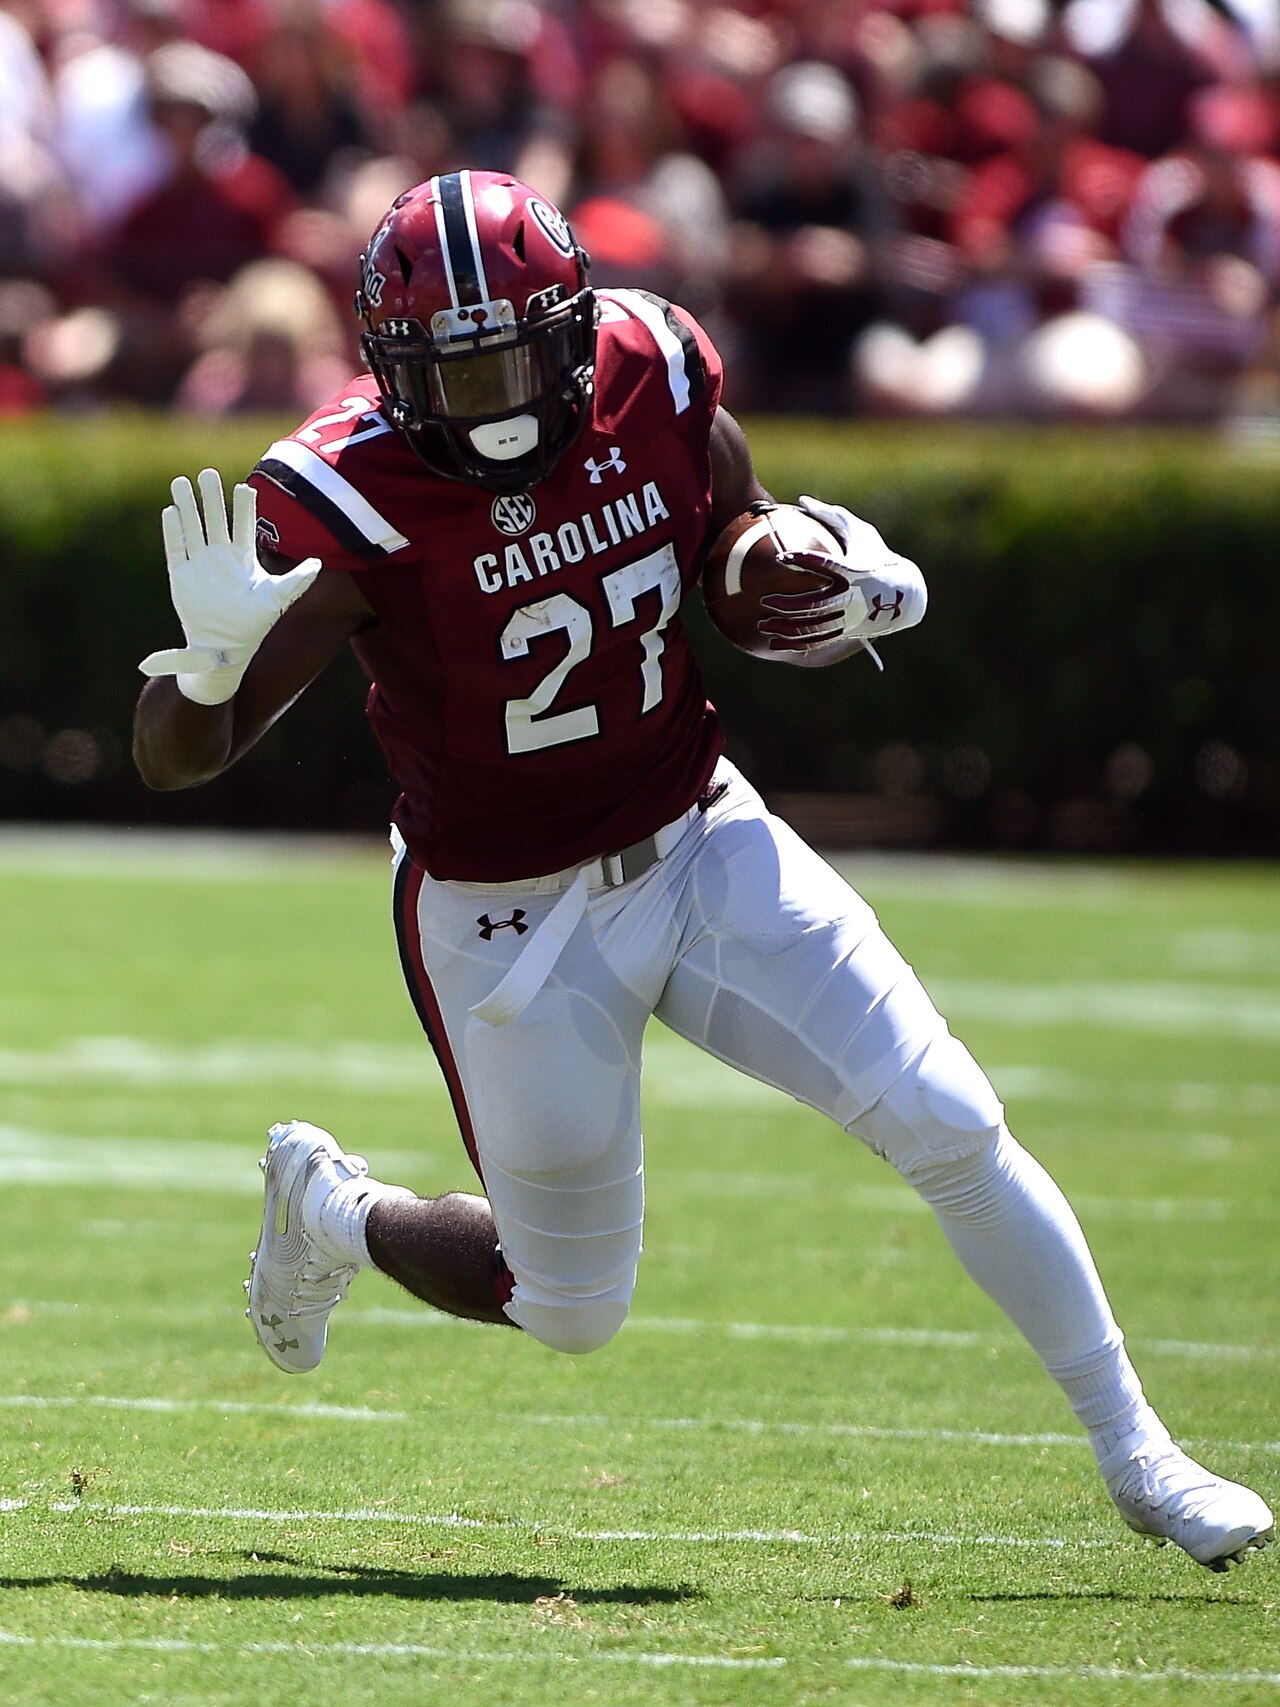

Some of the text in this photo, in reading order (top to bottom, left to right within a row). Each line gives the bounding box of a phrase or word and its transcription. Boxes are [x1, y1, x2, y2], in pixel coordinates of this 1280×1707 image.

[295, 394, 396, 455] 27
[473, 481, 670, 594] CAROLINA
[494, 494, 534, 533] SEC
[500, 541, 682, 754] 27
